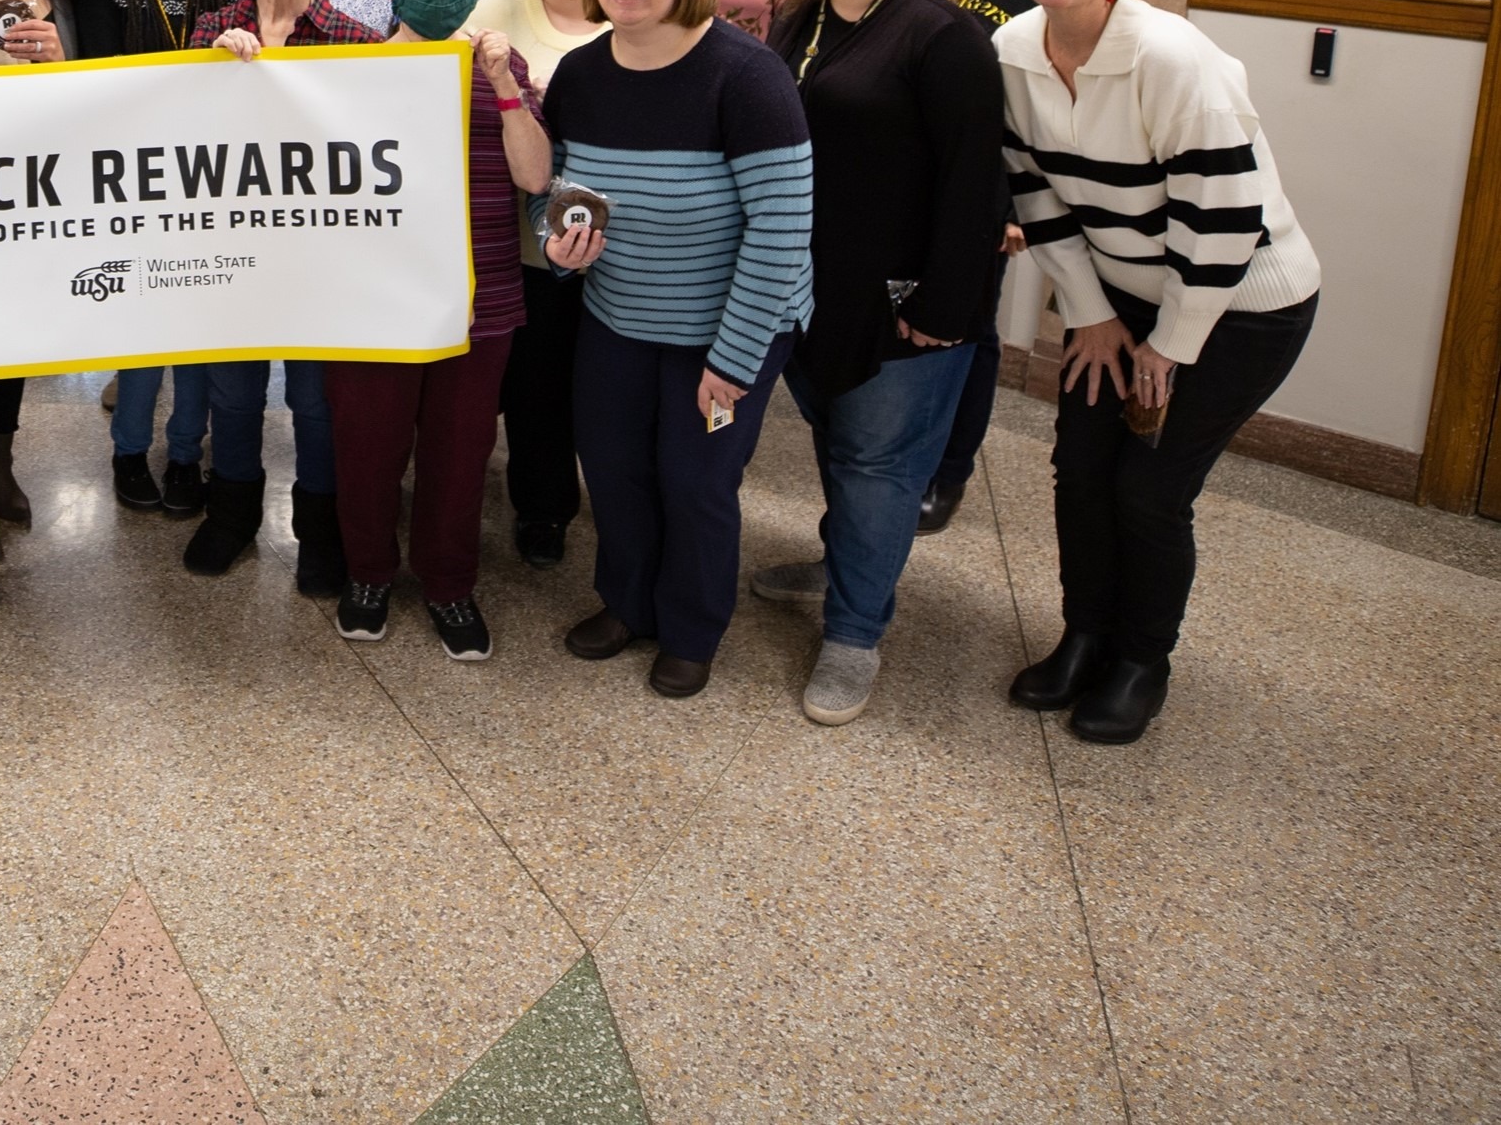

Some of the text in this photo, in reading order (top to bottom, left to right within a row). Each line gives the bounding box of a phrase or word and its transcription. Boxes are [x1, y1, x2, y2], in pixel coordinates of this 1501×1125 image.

[91, 139, 404, 205] REWARDS
[110, 216, 146, 235] OF
[158, 211, 215, 232] THE
[230, 208, 404, 230] PRESIDENT
